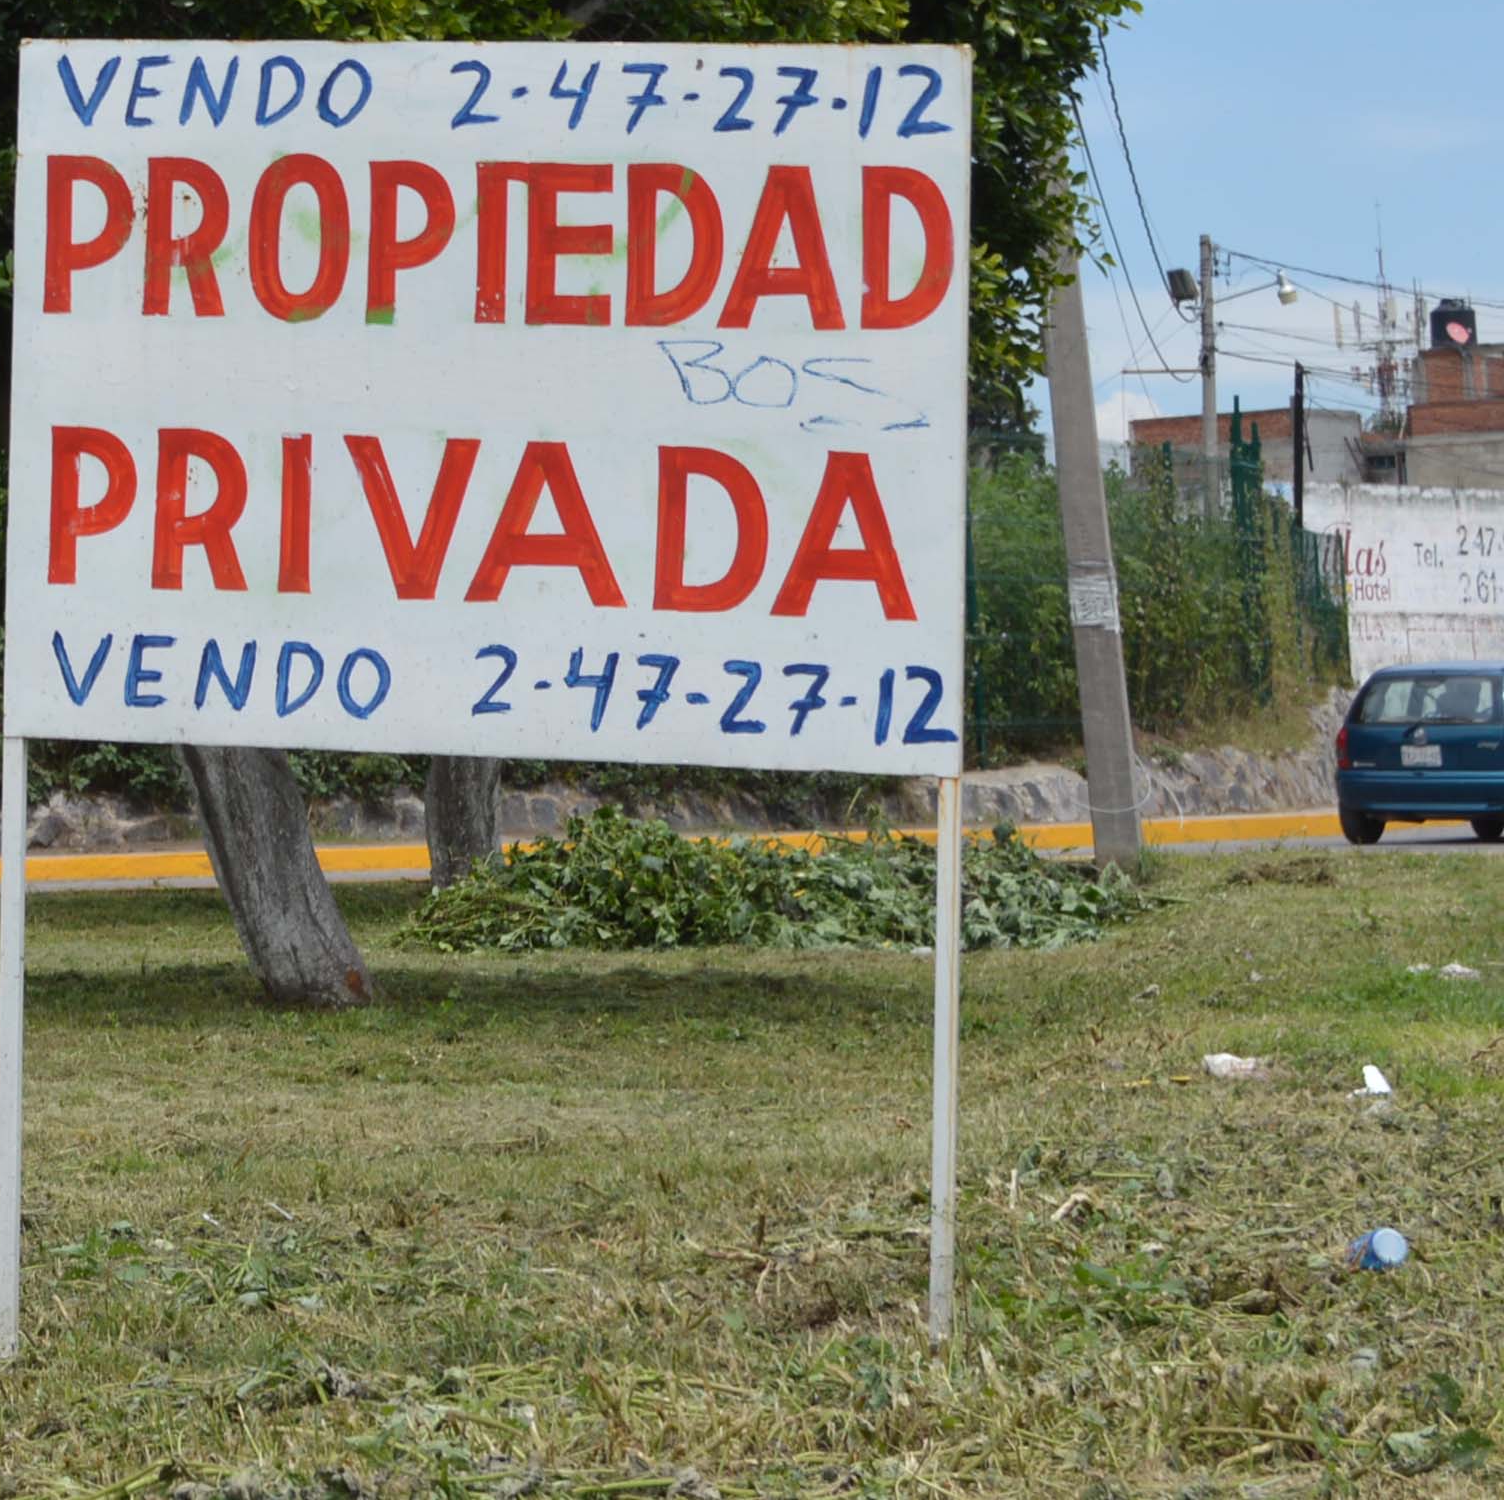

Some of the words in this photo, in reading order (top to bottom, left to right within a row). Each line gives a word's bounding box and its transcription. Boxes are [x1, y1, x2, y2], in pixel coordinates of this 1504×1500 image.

[57, 54, 372, 128] VENDO
[450, 58, 953, 138] 2-47-27-12
[42, 152, 955, 331] PROPIEDAD
[47, 425, 918, 621] PRIVADA
[1413, 542, 1444, 568] Tel.
[1353, 578, 1391, 601] Hotel
[52, 631, 391, 720] VENDO
[471, 644, 959, 745] 2-47-27-12
